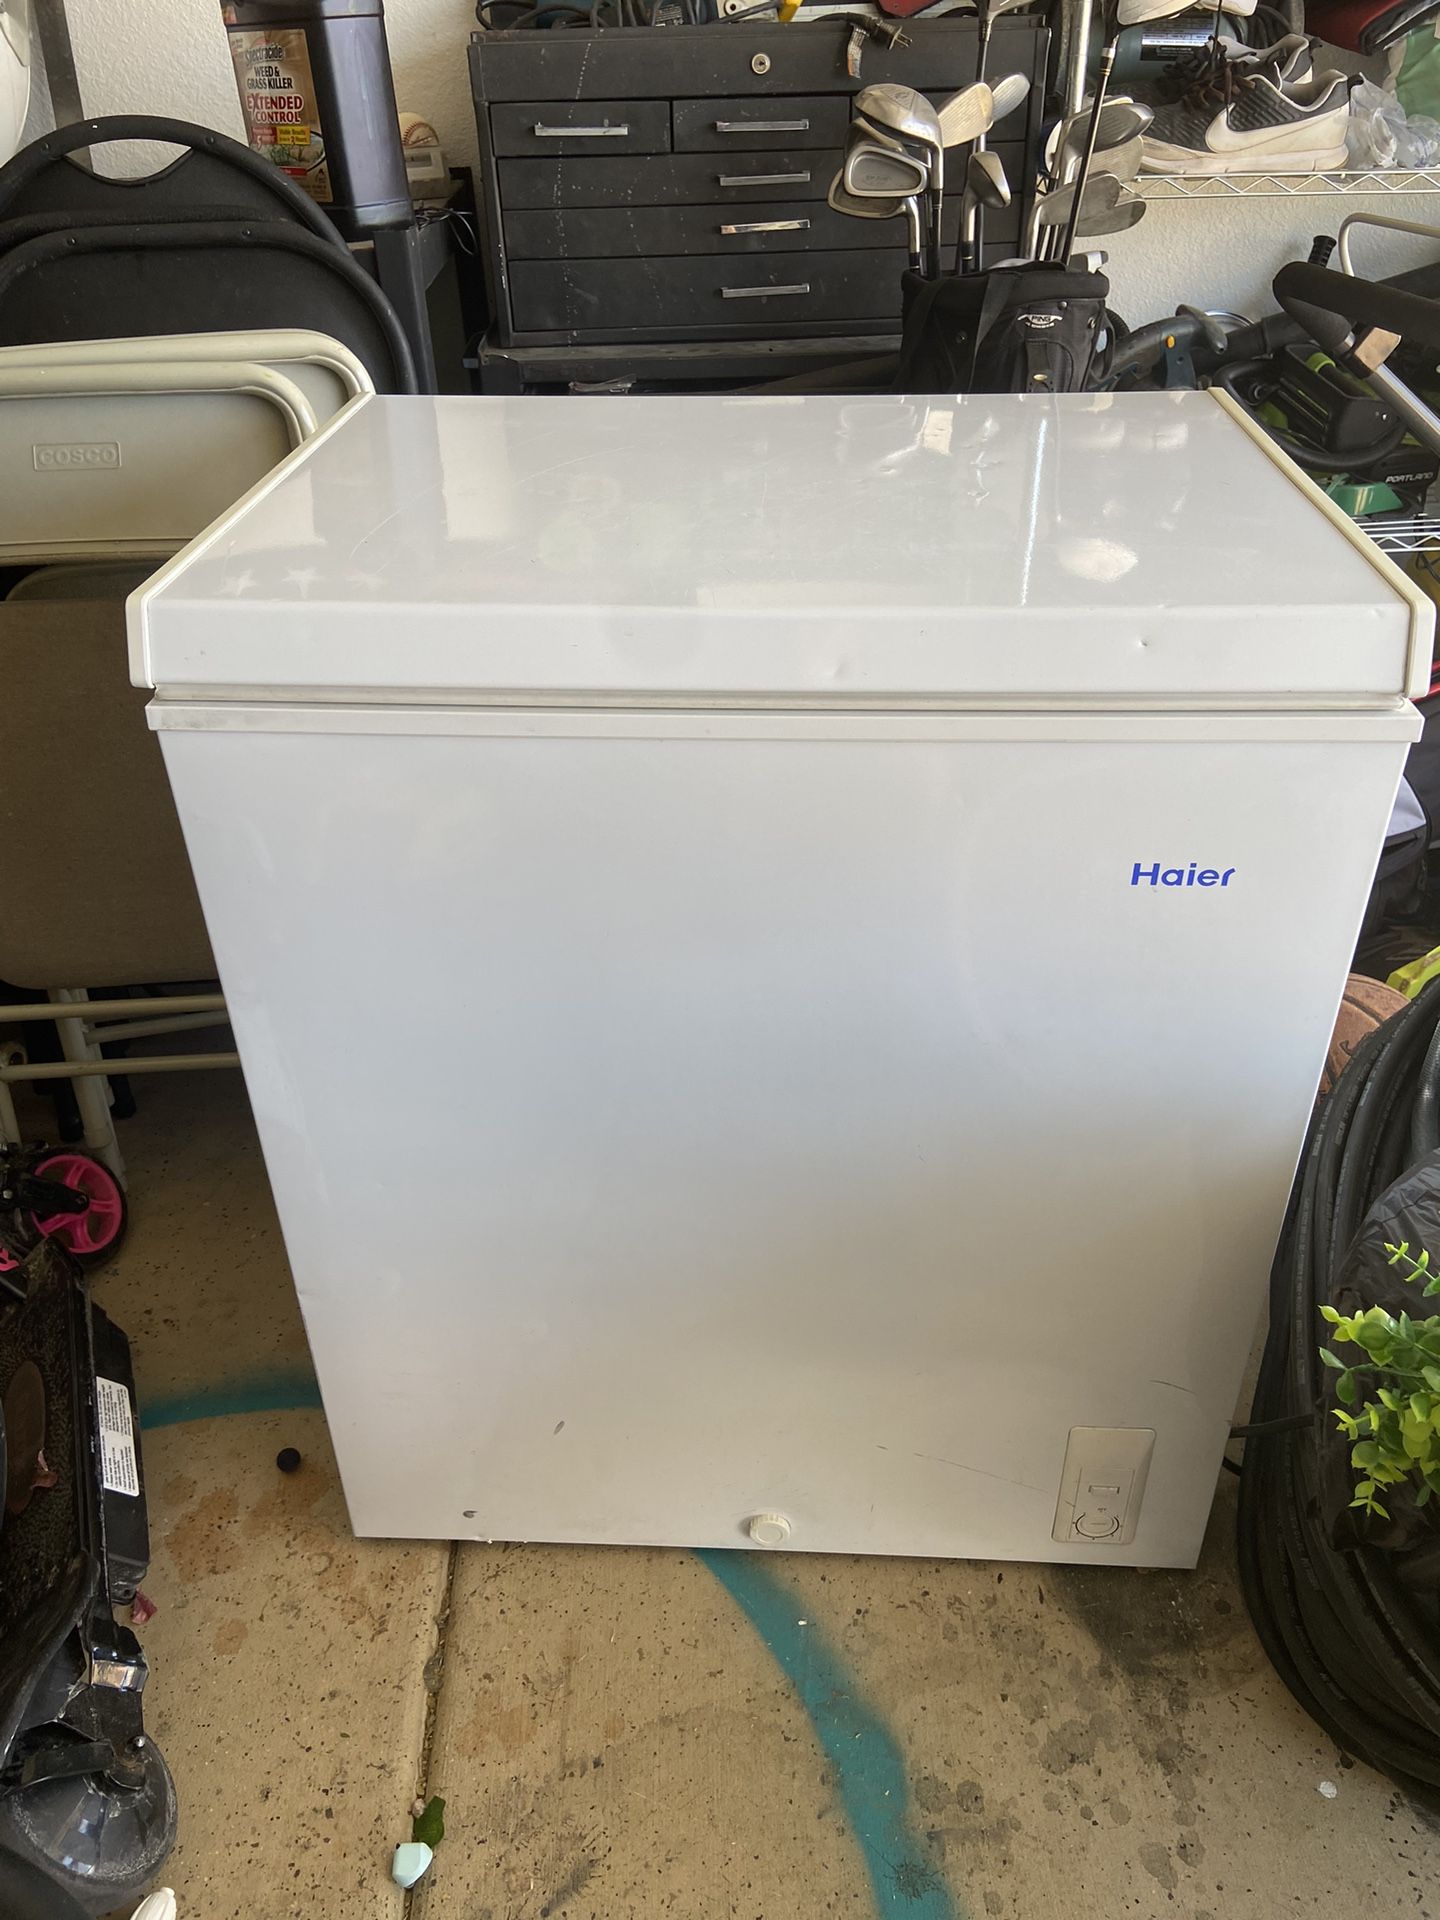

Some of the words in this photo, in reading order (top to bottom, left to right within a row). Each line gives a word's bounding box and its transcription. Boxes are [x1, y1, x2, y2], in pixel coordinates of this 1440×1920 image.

[254, 65, 274, 78] WEED
[274, 66, 281, 77] &
[247, 78, 268, 90] GRASS
[268, 77, 293, 89] KILLER
[246, 93, 304, 112] EXTENDED
[255, 111, 300, 123] CONTROL
[39, 447, 118, 465] COSCO
[1385, 471, 1434, 483] PORTLAND
[1130, 862, 1236, 887] Haier
